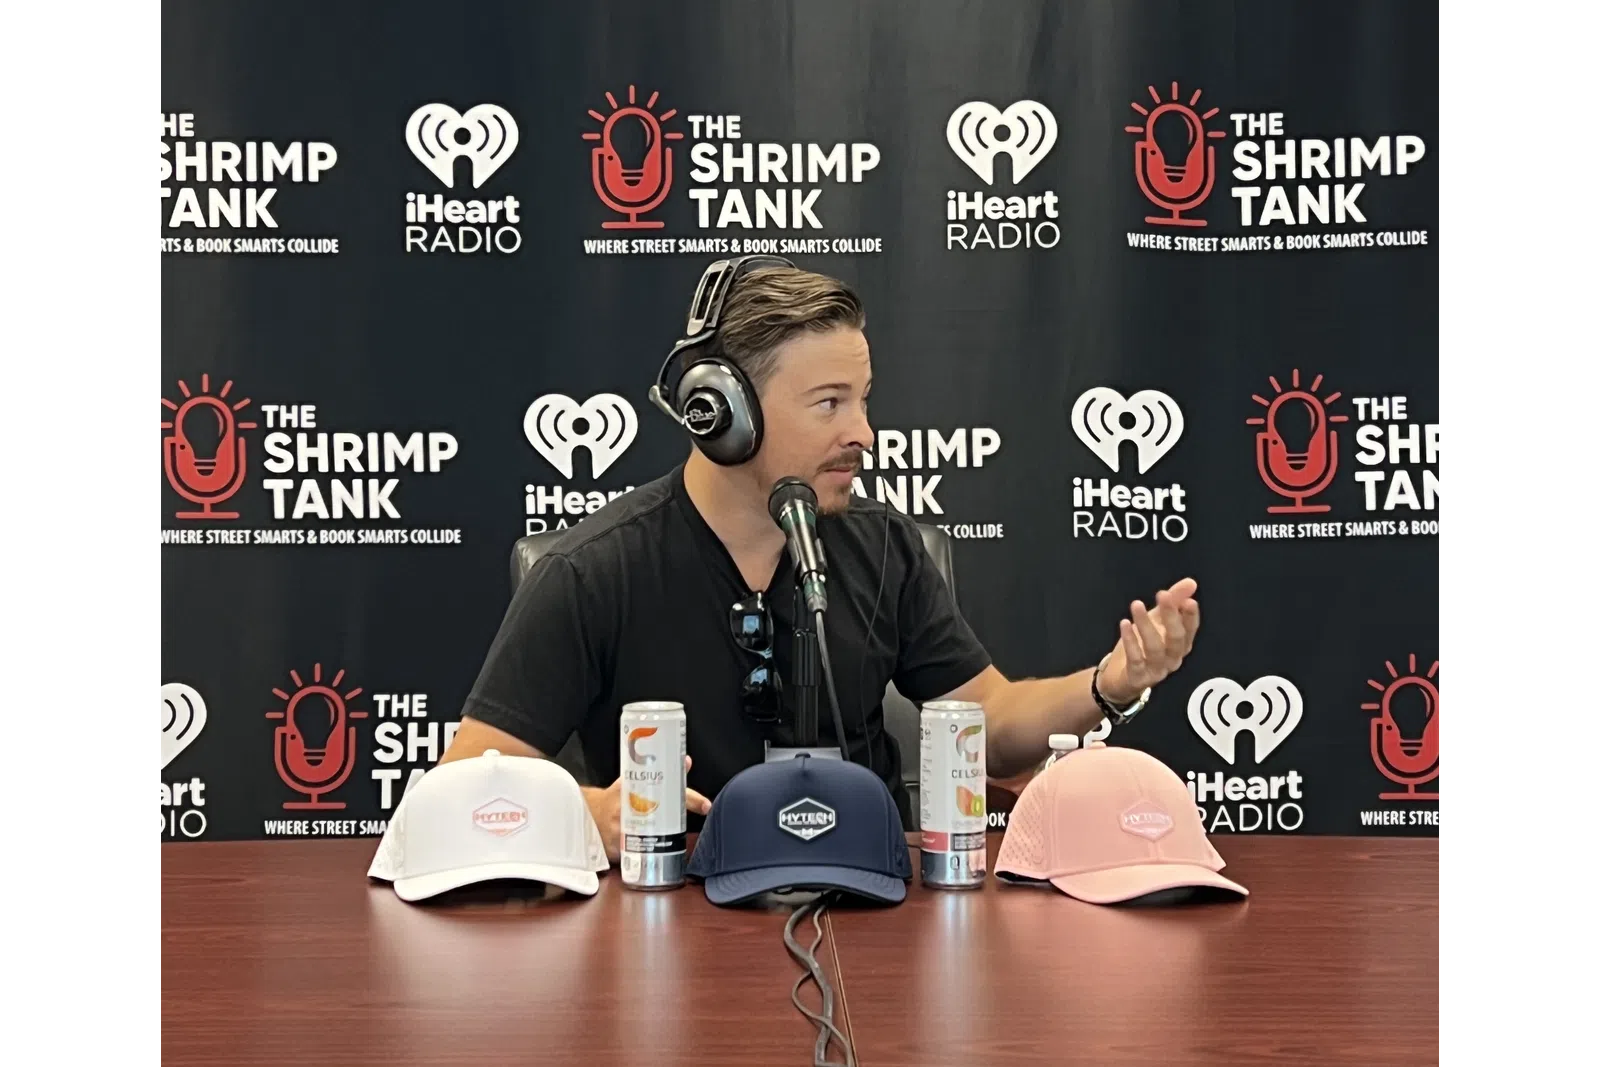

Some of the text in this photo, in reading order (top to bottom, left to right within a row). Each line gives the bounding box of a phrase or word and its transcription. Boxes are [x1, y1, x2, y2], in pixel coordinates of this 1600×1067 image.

[688, 115, 741, 138] THE
[1230, 113, 1283, 136] THE
[690, 143, 880, 183] SHRIMP
[1233, 133, 1425, 181] SHRIMP
[406, 192, 520, 223] iHeart
[689, 189, 823, 228] TANK
[947, 190, 1058, 220] iHeart
[1232, 183, 1367, 226] TANK
[183, 238, 194, 252] &
[197, 238, 231, 252] BOOK
[234, 238, 285, 252] SMARTS
[287, 238, 338, 253] COLLIDE
[406, 226, 521, 253] RADIO
[584, 238, 882, 253] WHERE STREET SMARTS & BOOK SMARTS COLLIDE
[948, 219, 1060, 250] RADIO
[1127, 231, 1427, 251] WHERE STREET SMARTS & BOOK SMARTS COLLIDE
[261, 405, 316, 428] THE
[1353, 396, 1407, 421] THE
[264, 432, 458, 473] SHRIMP
[263, 479, 401, 519] TANK
[1073, 477, 1185, 511] iHeart
[160, 529, 461, 544] WHERE STREET SMARTS & BOOK SMARTS COLLIDE
[953, 524, 1003, 538] COLLIDE
[1074, 509, 1188, 542] RADIO
[1250, 519, 1440, 538] WHERE STREET SMARTS & BOO
[373, 694, 427, 717] THE
[1187, 770, 1303, 802] iHeart
[265, 820, 391, 835] WHERE STREET SMA
[1361, 810, 1440, 825] WHERE STRE
